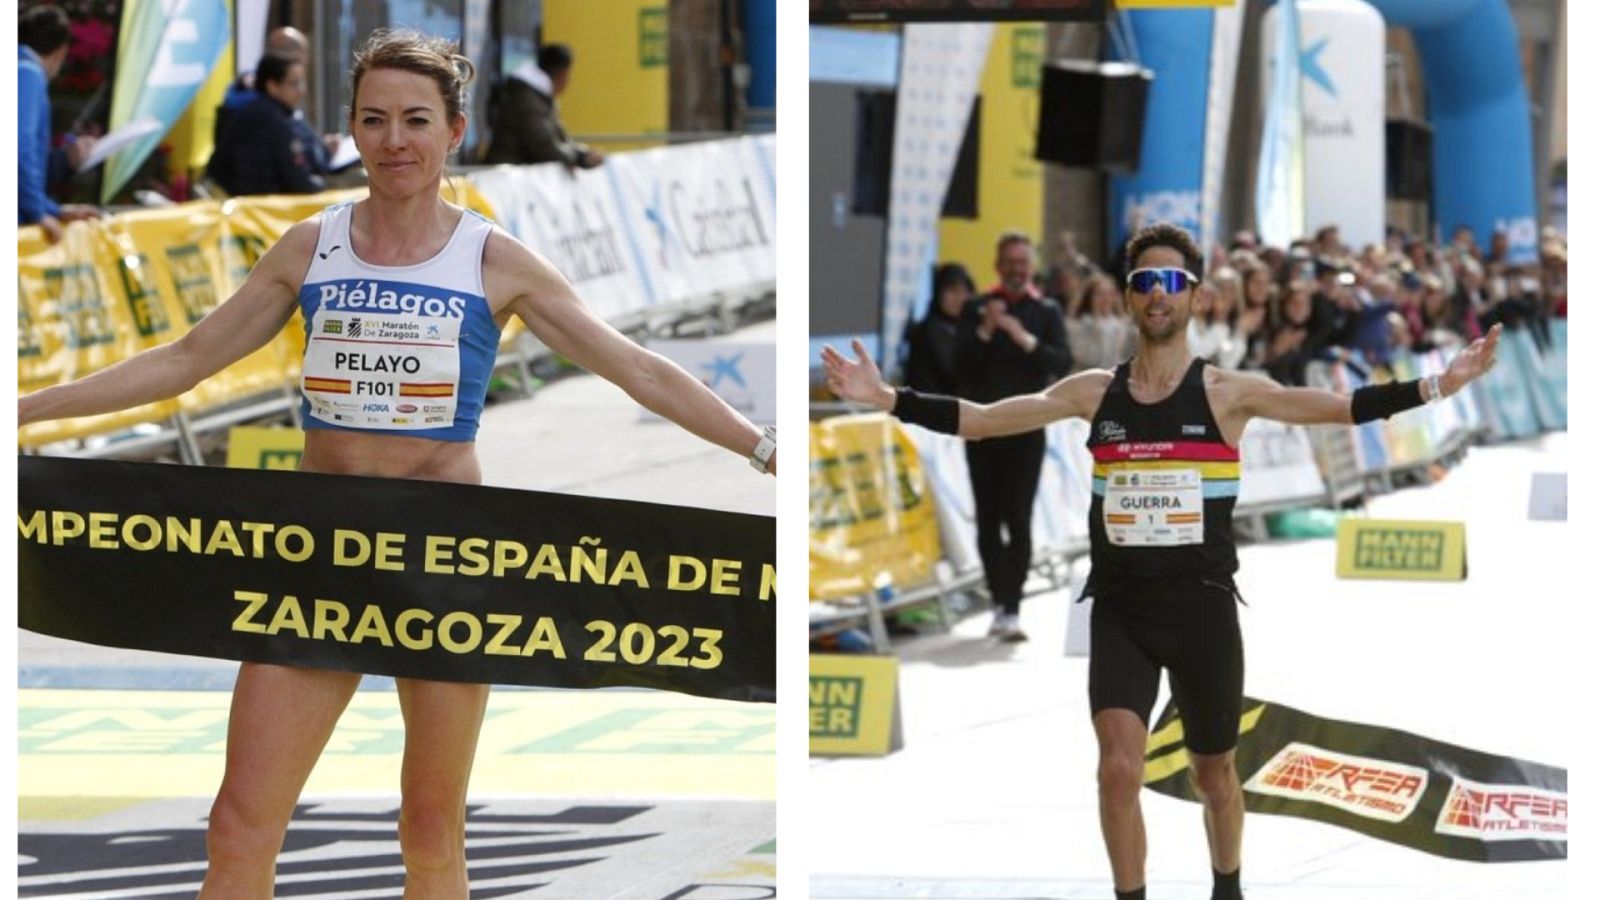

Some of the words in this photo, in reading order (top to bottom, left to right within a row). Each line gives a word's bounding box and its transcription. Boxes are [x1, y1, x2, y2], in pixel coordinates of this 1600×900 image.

[364, 321, 380, 329] XVI
[382, 321, 420, 331] Maratón
[364, 329, 376, 337] De
[378, 330, 420, 340] Zaragoza
[334, 352, 421, 374] PELAYO
[356, 381, 395, 397] F101
[363, 403, 390, 413] HOKA
[1120, 496, 1182, 509] GUERRA
[1148, 514, 1154, 524] 1
[18, 510, 315, 563] MPEONATO
[333, 528, 406, 572] DE
[424, 535, 650, 588] ESPAÑA
[667, 554, 743, 597] DE
[232, 590, 566, 660] ZARAGOZA
[584, 619, 724, 670] 2023
